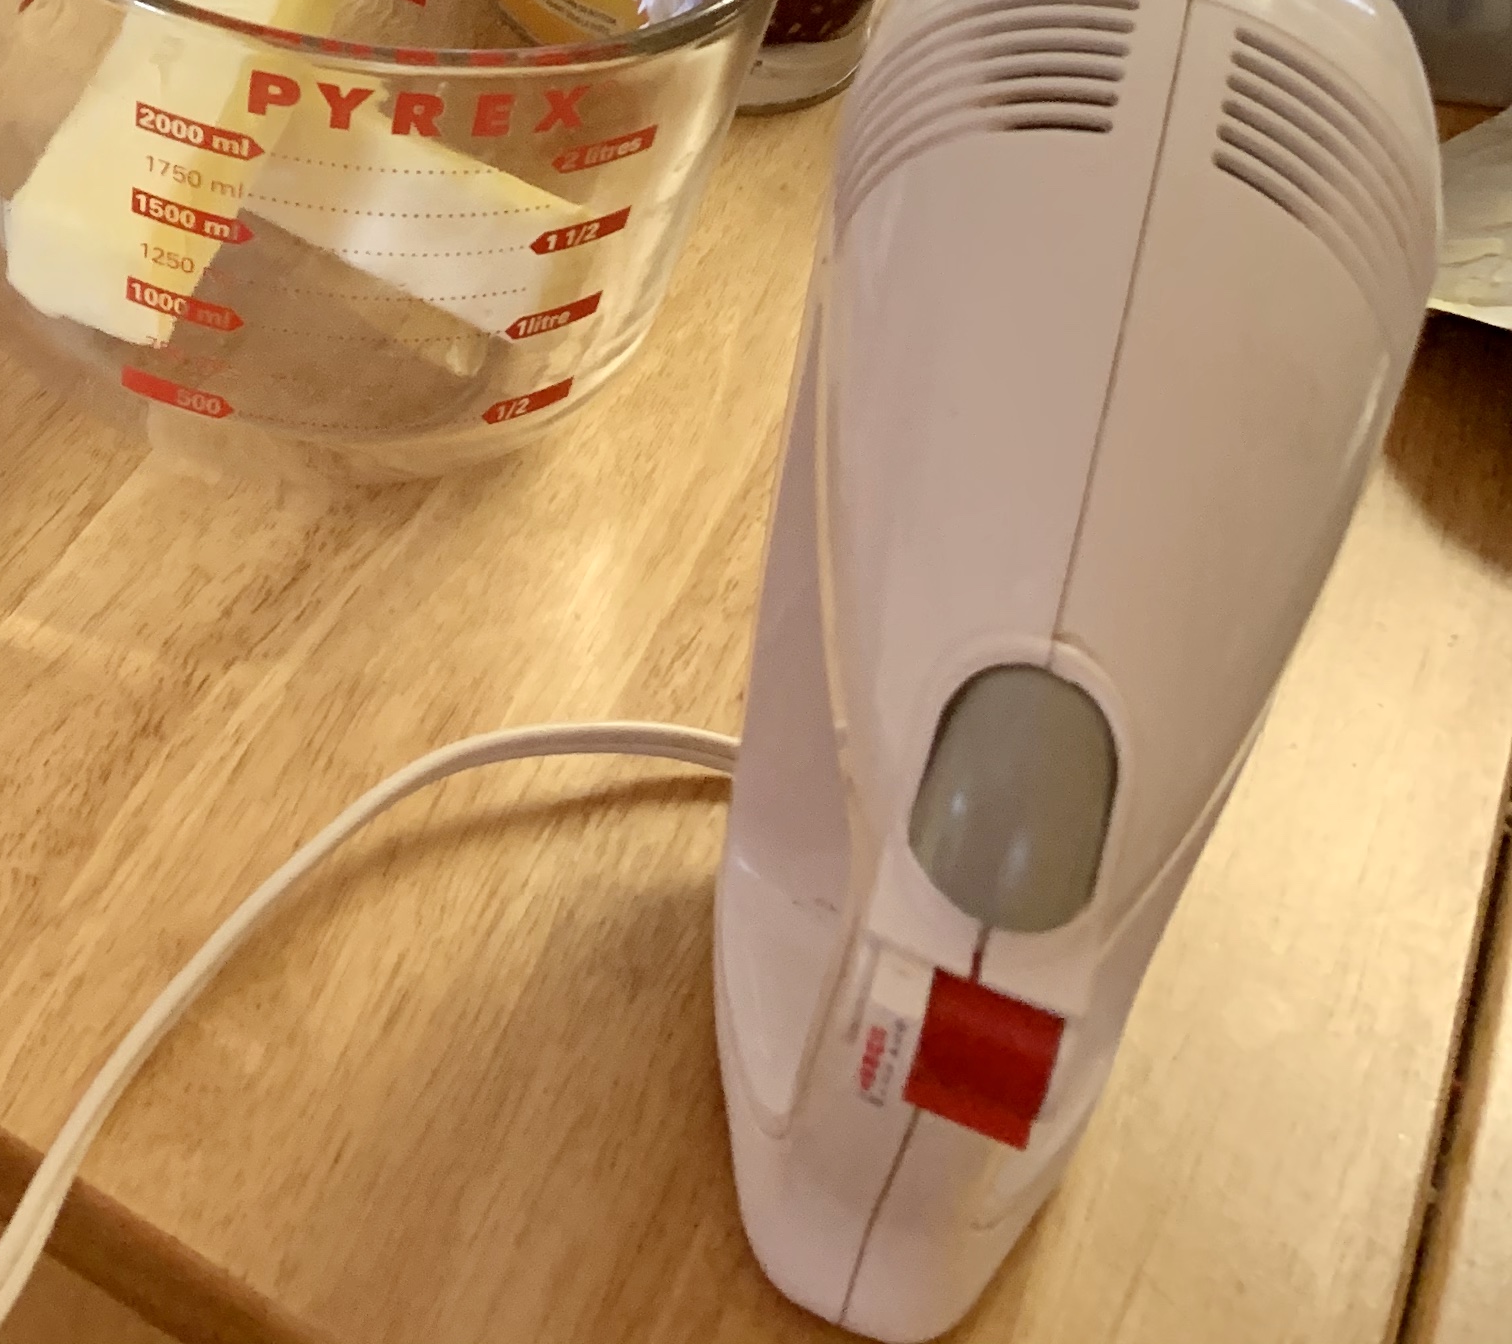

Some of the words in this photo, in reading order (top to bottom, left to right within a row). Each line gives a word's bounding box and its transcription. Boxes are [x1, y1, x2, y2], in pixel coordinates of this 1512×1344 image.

[247, 69, 591, 138] PYREX
[138, 107, 204, 144] 2000
[211, 134, 250, 156] ml
[585, 137, 642, 166] litres
[145, 155, 202, 189] 1750
[211, 179, 243, 198] ml
[135, 194, 196, 229] 1500
[546, 230, 557, 252] 1
[565, 222, 600, 247] 1/2
[140, 242, 195, 274] 1250
[130, 282, 187, 315] 1000
[177, 389, 222, 415] 500
[496, 397, 530, 422] 1/2
